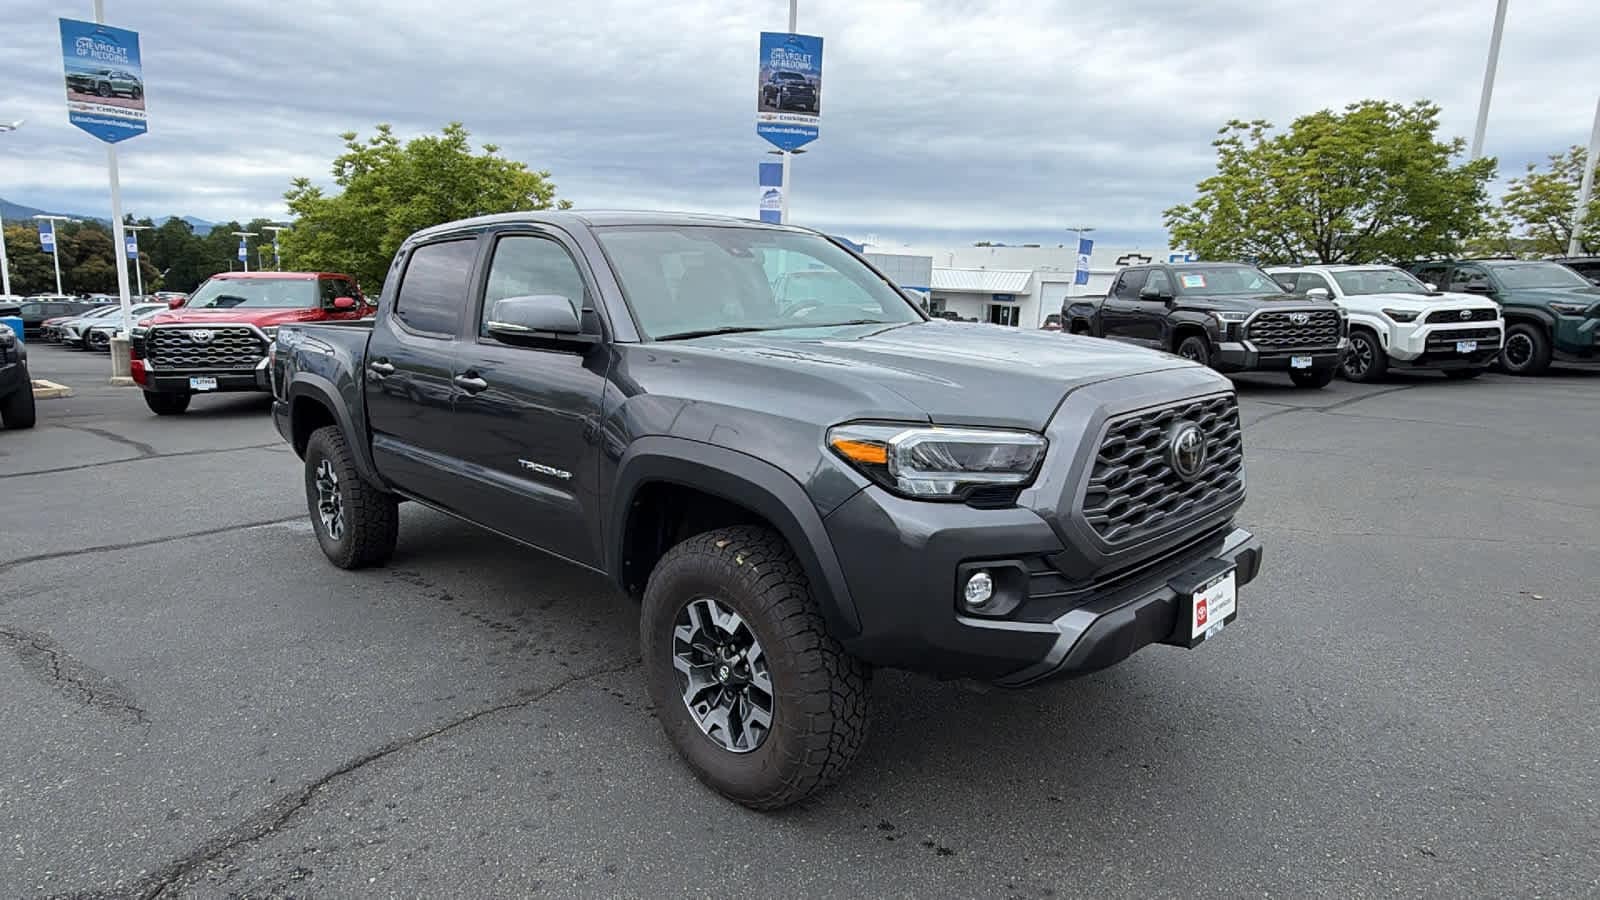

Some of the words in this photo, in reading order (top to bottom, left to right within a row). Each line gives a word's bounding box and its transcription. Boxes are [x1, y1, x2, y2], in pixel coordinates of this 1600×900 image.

[75, 40, 128, 55] CHEVROLET
[76, 49, 88, 57] OF
[91, 51, 129, 64] REDDING
[771, 51, 812, 63] CHEVROLET
[781, 60, 812, 70] REDDING
[97, 106, 146, 118] CHEVROLET
[518, 458, 573, 480] TACOMA
